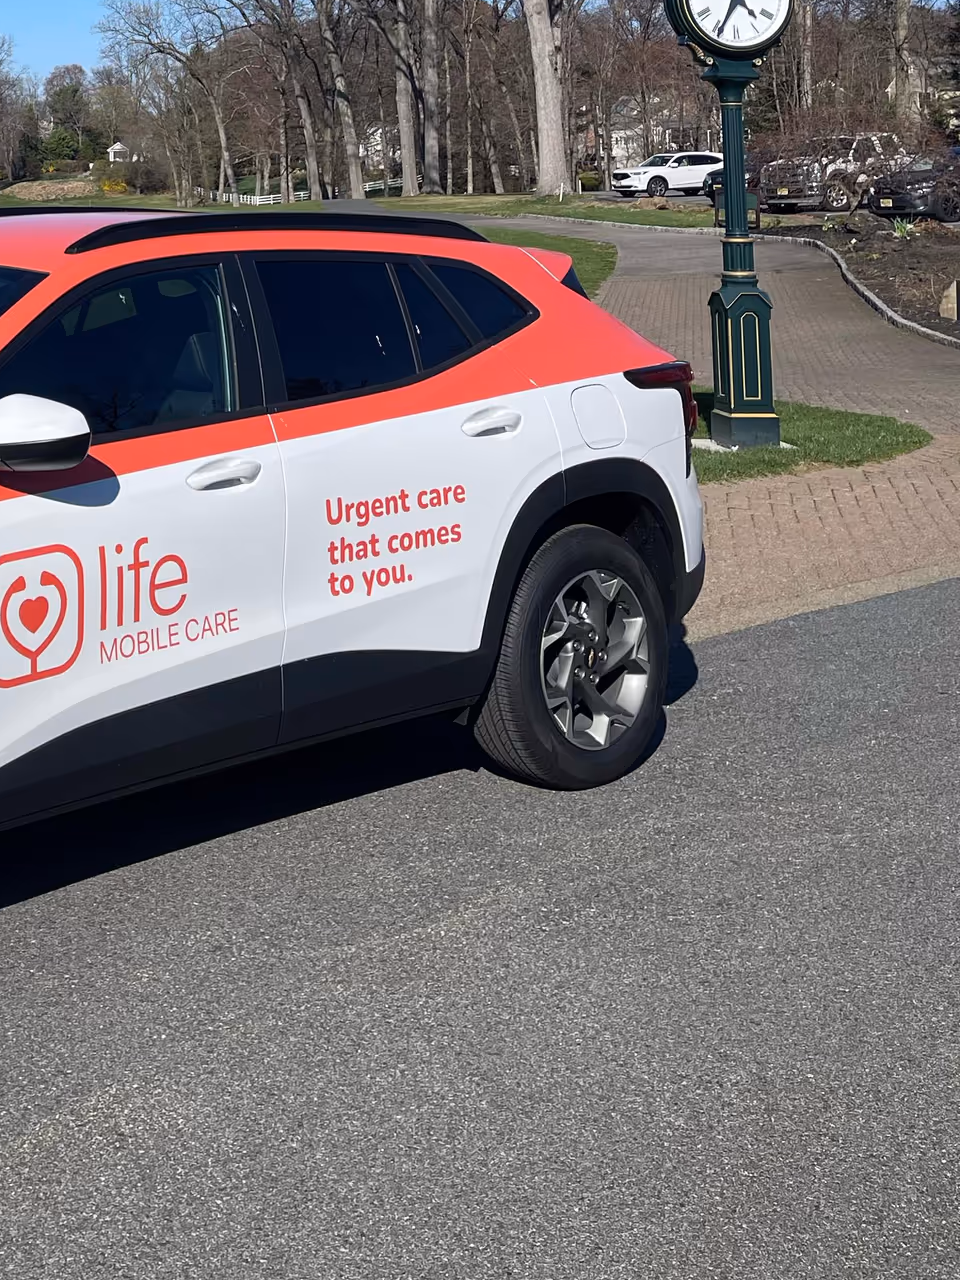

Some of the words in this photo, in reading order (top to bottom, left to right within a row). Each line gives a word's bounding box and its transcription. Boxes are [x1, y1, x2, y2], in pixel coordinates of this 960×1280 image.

[325, 488, 411, 528] Urgent
[417, 484, 466, 510] care
[327, 533, 381, 566] that
[387, 523, 462, 554] comes
[98, 536, 188, 631] life
[327, 572, 355, 597] to
[361, 563, 413, 597] you.
[100, 622, 181, 664] MOBILE
[185, 608, 240, 643] CARE
